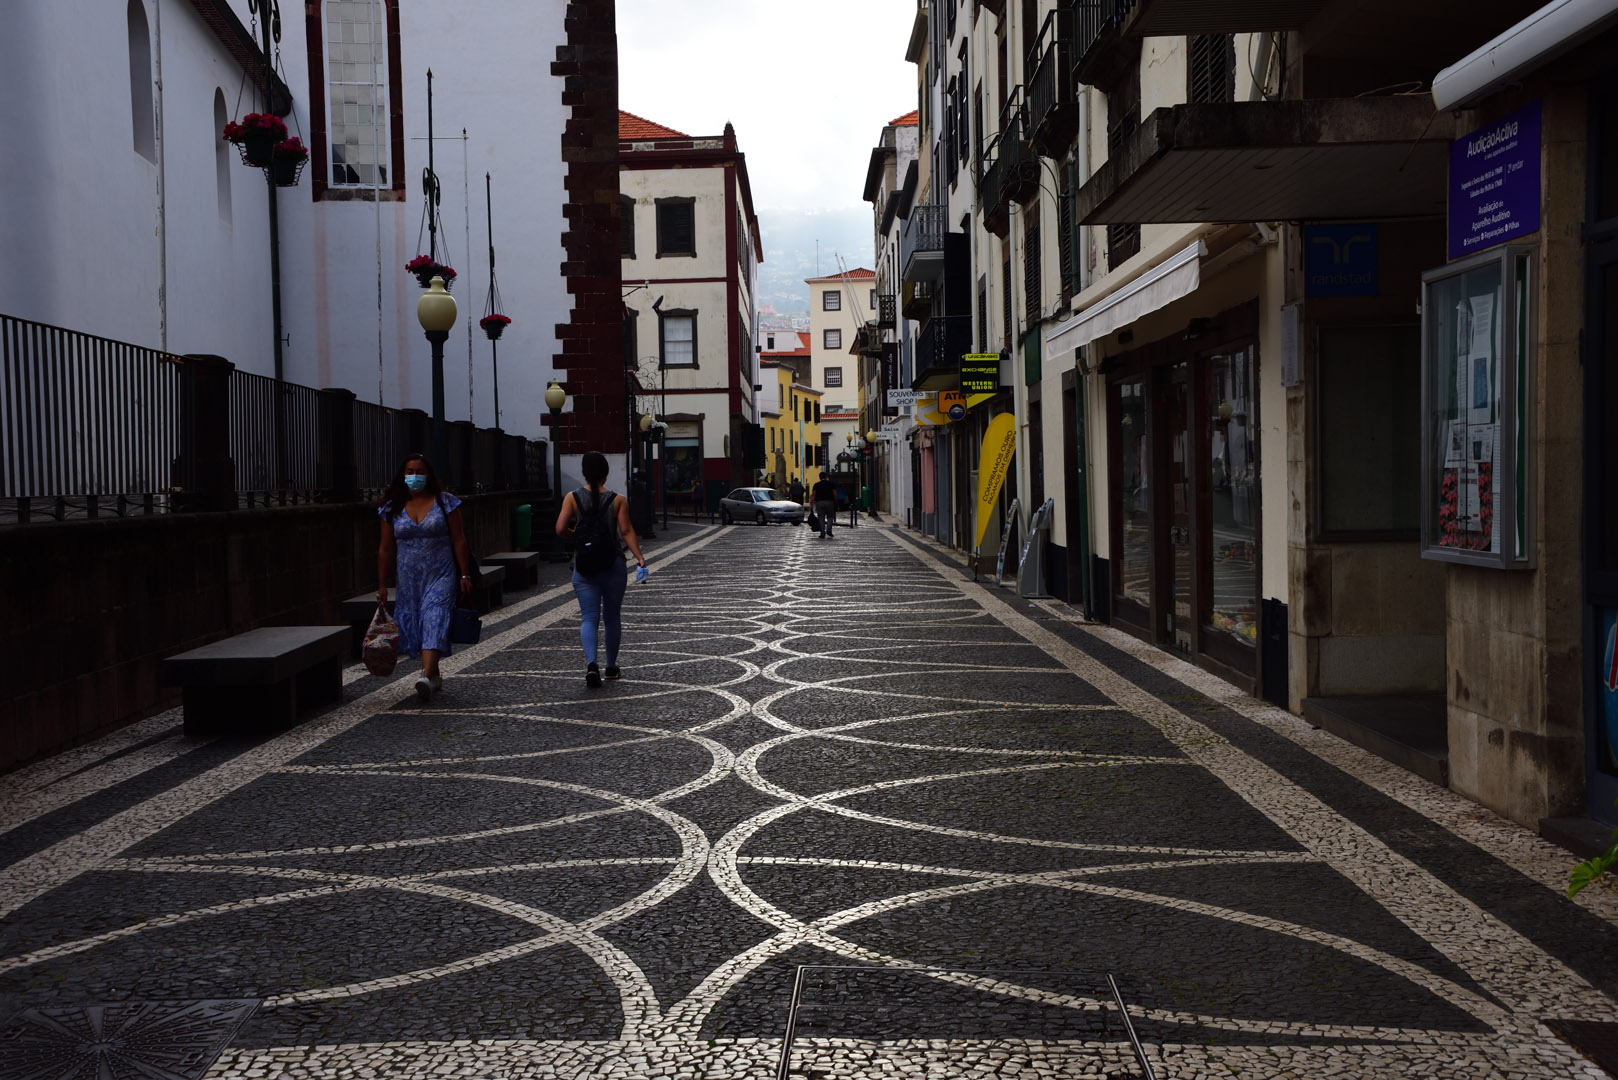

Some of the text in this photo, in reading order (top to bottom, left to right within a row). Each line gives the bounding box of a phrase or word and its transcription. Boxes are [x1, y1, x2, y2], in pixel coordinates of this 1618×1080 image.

[1478, 201, 1499, 216] Avaliação
[1472, 210, 1511, 232] Aparelho Auditivo
[1508, 221, 1520, 230] Pilhas
[1311, 271, 1372, 285] randstad
[983, 430, 1013, 502] COMPRAMOS OURO
[988, 475, 1002, 505] PAGAMOS
[999, 462, 1006, 474] EM
